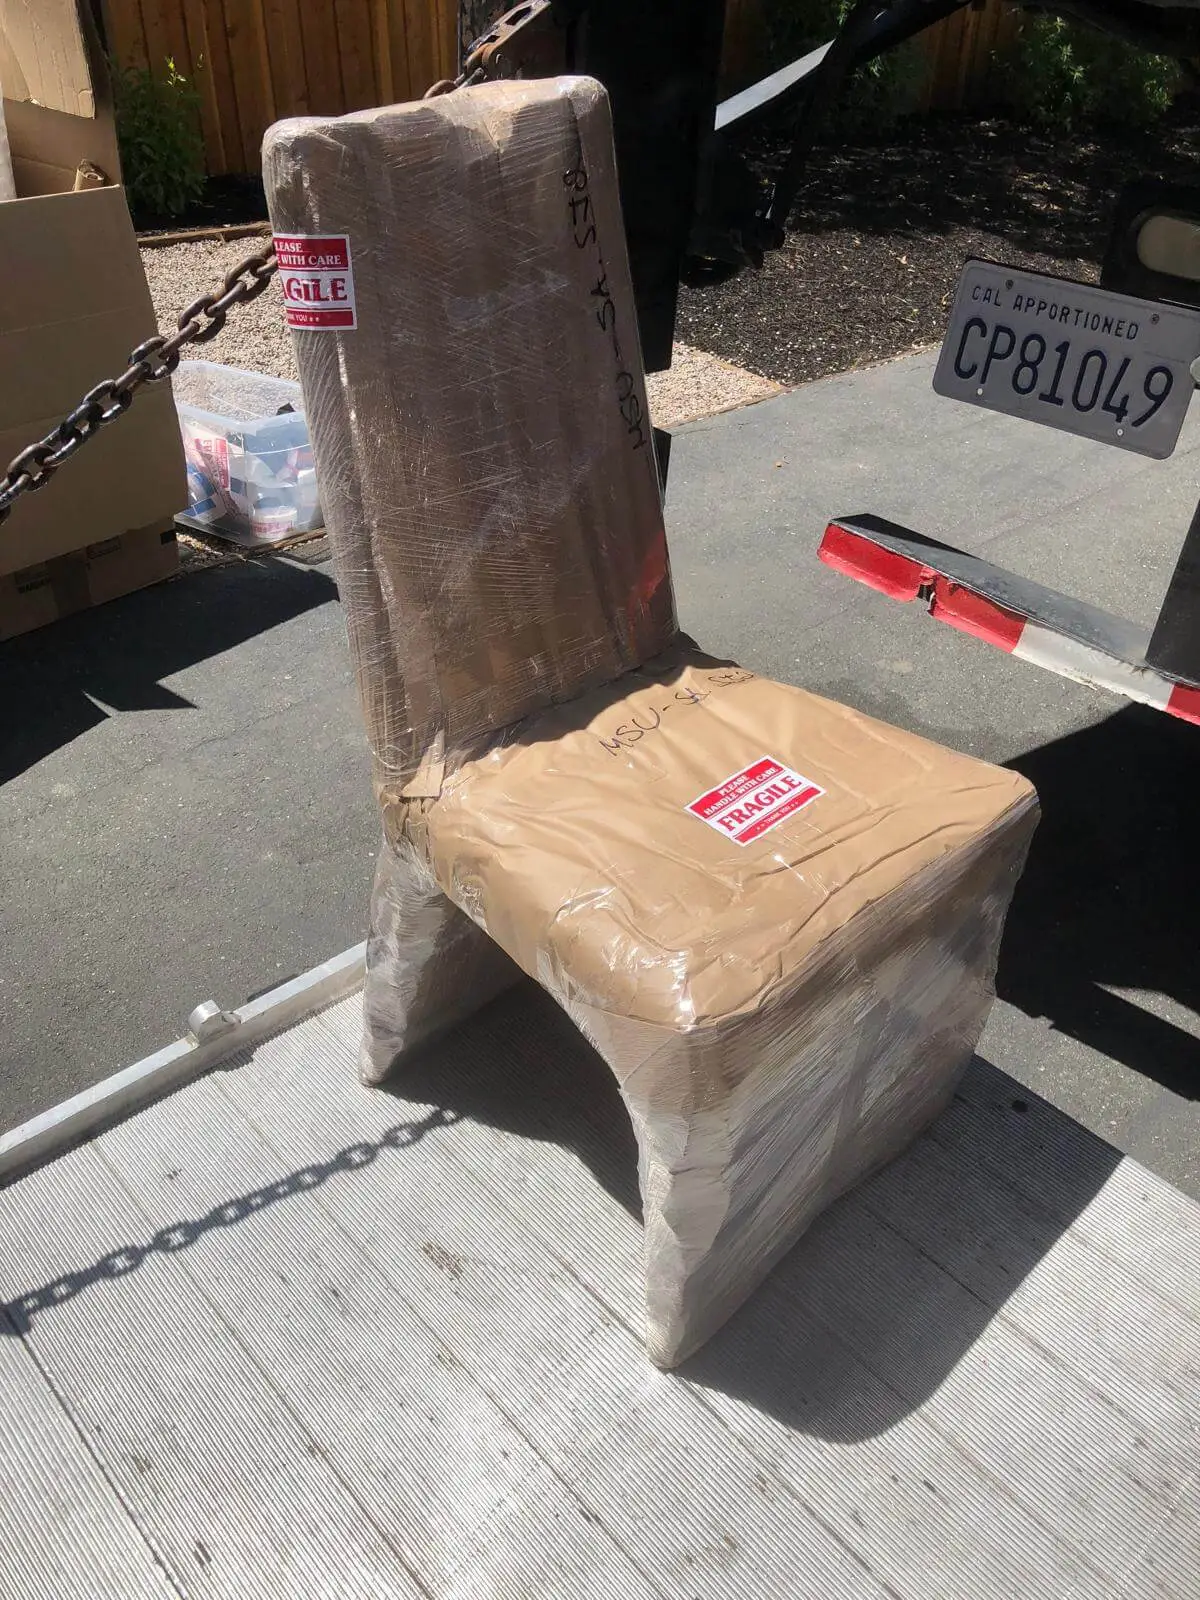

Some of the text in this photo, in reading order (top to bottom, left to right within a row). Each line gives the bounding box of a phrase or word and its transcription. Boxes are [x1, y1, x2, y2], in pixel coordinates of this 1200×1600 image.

[281, 254, 305, 265] WITH
[308, 254, 342, 265] CARE
[972, 285, 1140, 341] CAL APPORTIONED
[953, 316, 1175, 428] CP81049
[703, 767, 778, 815] HANDLE WITH CARE
[717, 775, 803, 832] FRAGILE
[719, 774, 751, 796] PLEASE
